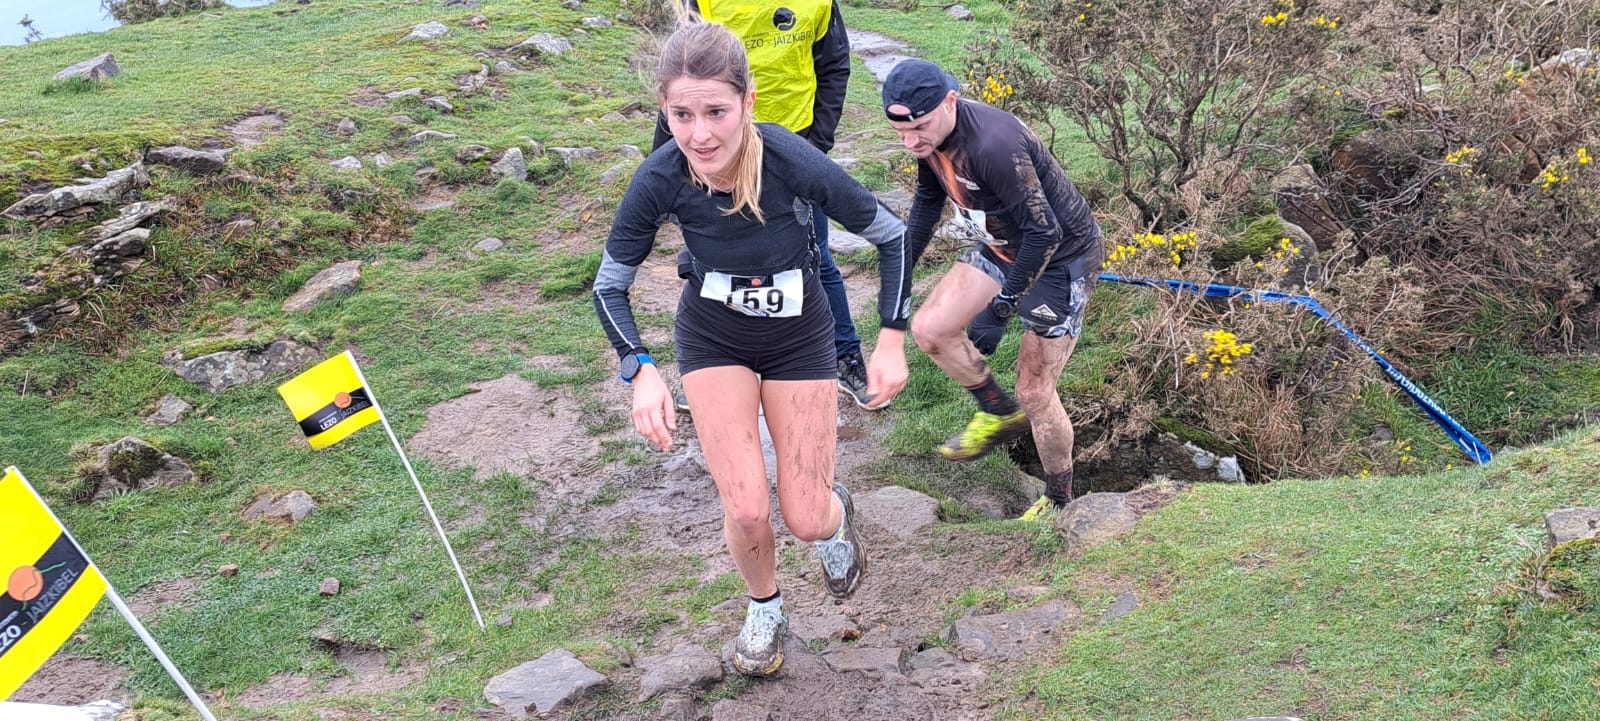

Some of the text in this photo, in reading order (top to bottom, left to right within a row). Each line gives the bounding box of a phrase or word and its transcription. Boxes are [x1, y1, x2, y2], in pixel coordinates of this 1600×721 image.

[745, 39, 764, 49] EZO
[320, 417, 337, 430] LEZO
[26, 568, 79, 624] JAIZKIBEL
